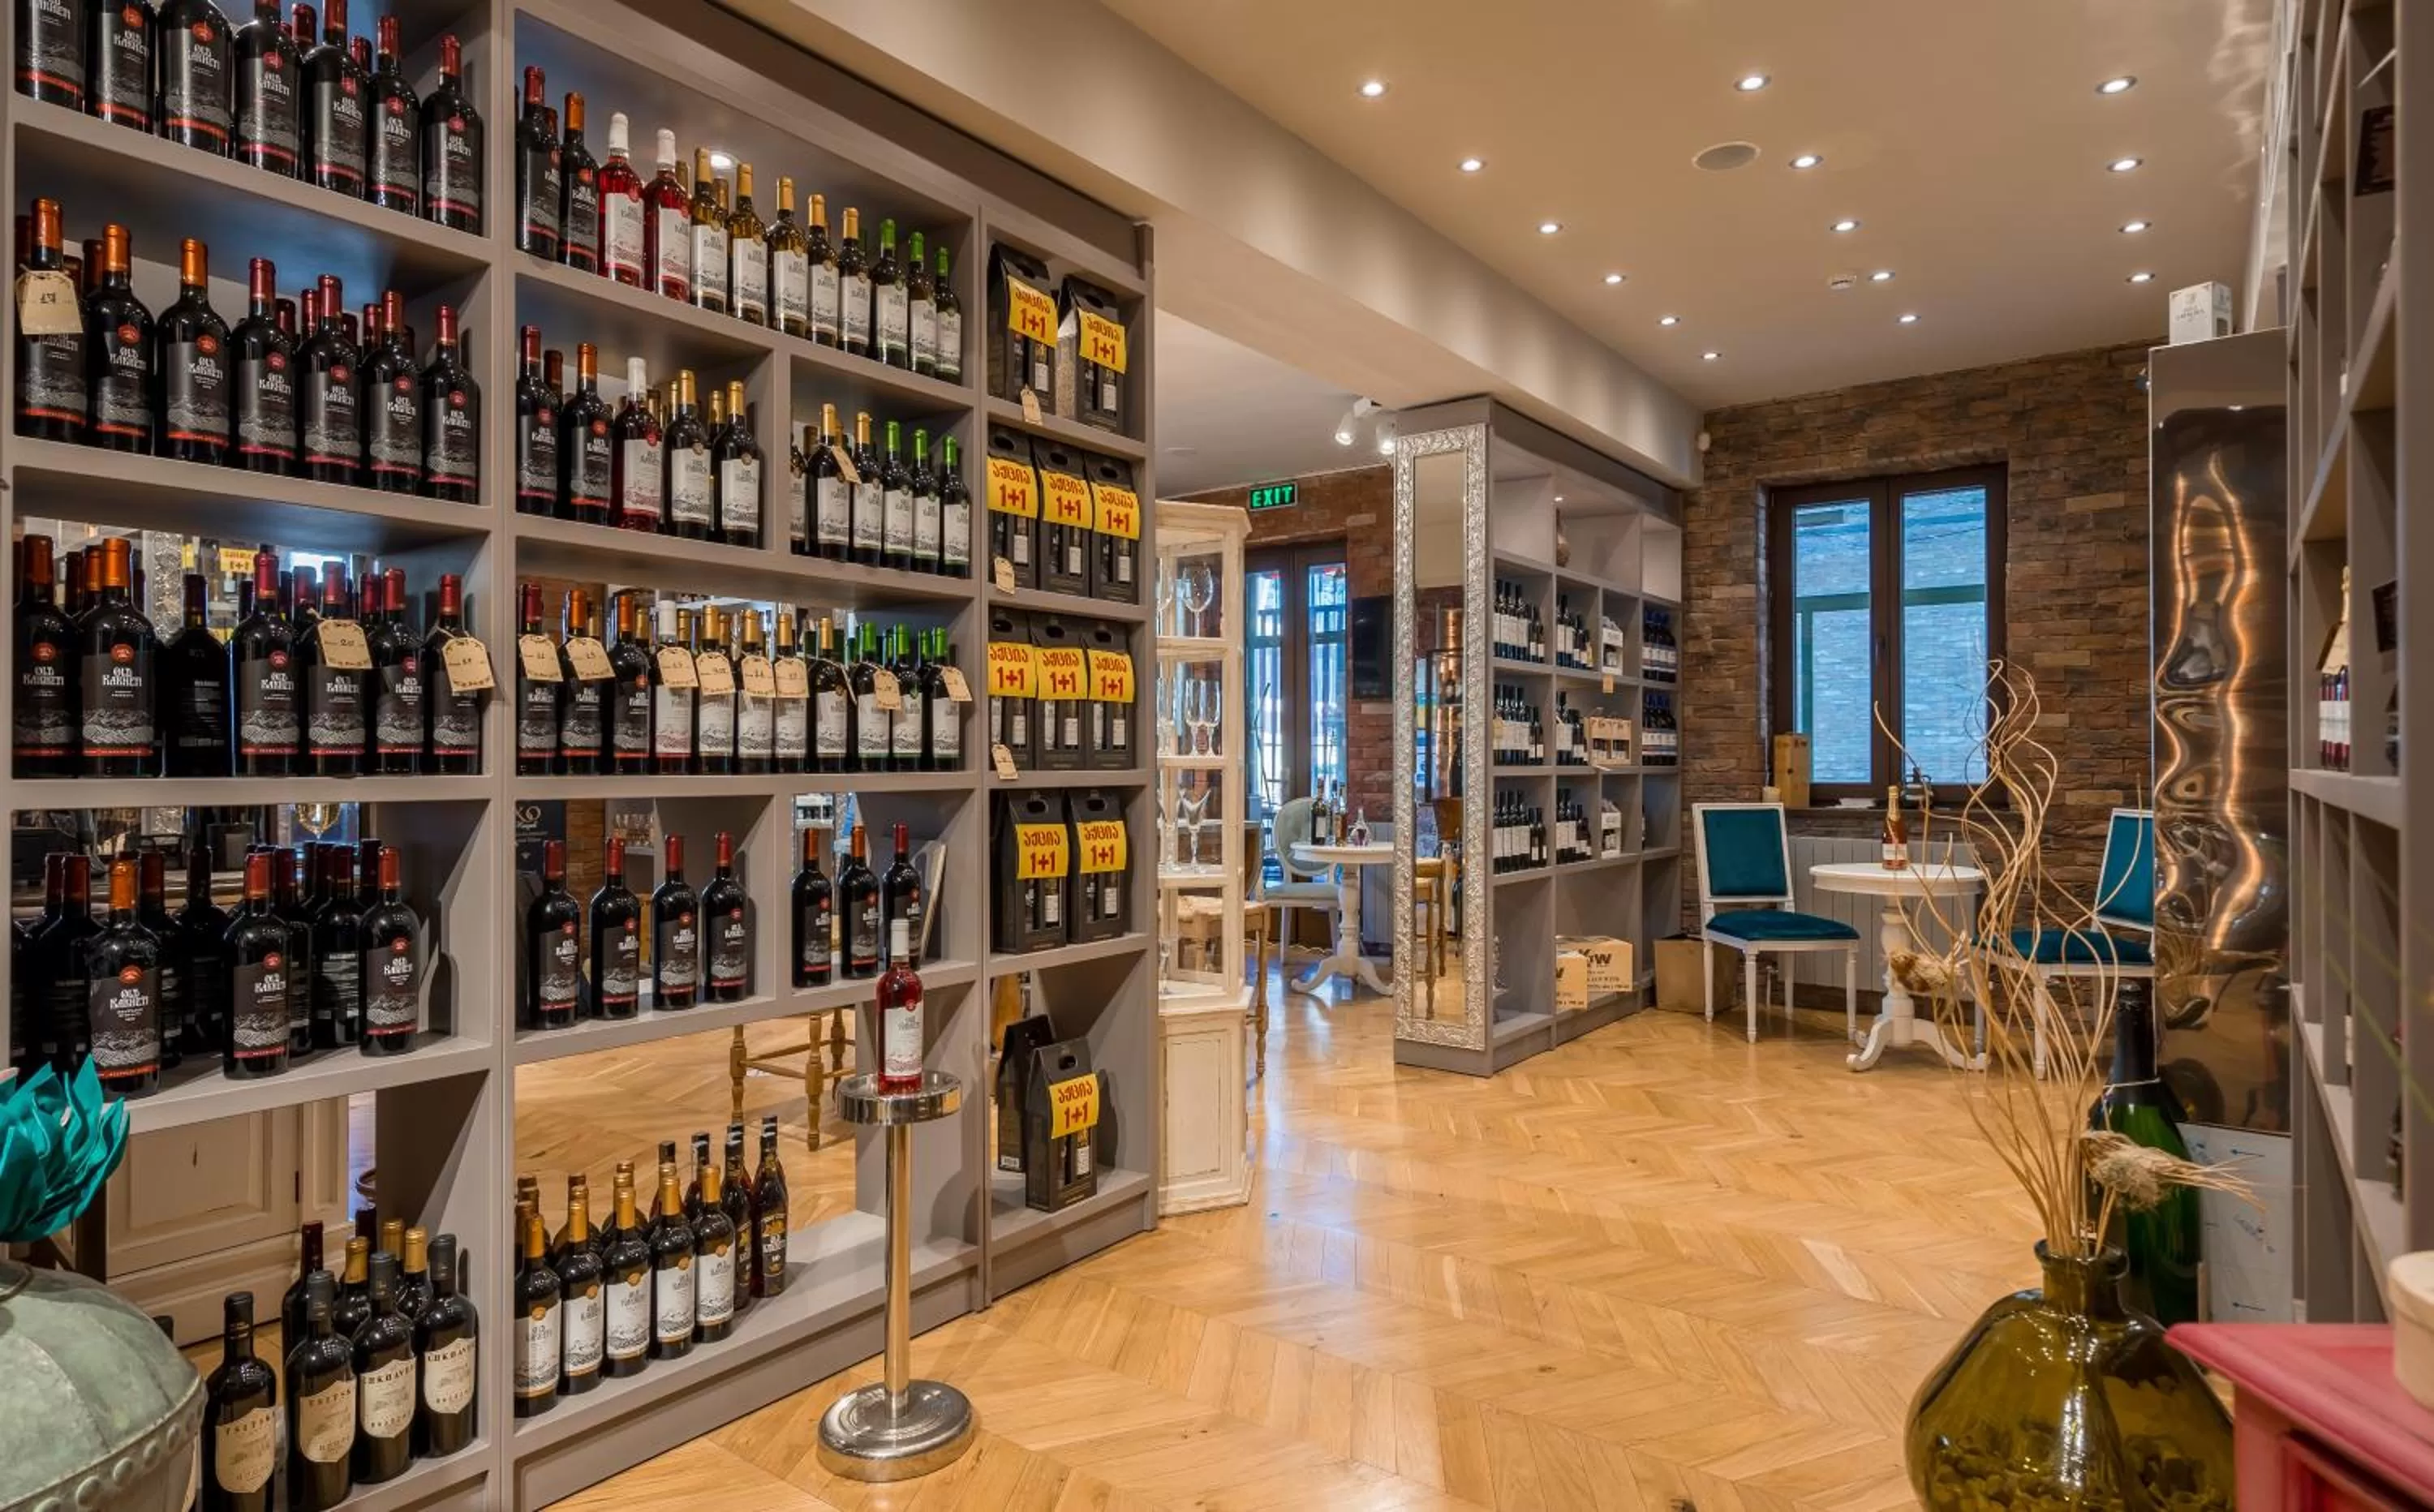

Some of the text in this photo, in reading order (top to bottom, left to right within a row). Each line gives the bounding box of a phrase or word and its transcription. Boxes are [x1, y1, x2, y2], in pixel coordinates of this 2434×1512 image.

[1020, 307, 1046, 338] 1+1
[1092, 337, 1116, 364] 1+1
[1000, 483, 1026, 510] 1+1
[1056, 495, 1082, 521] 1+1
[1252, 486, 1292, 507] EXIT
[1106, 509, 1129, 532] 1+1
[996, 666, 1025, 690] 1+1
[1049, 671, 1077, 694] 1+1
[1100, 675, 1124, 698] 1+1
[1030, 850, 1056, 874] 1+1
[1090, 844, 1114, 867] 1+1
[1064, 1101, 1088, 1129] 1+1
